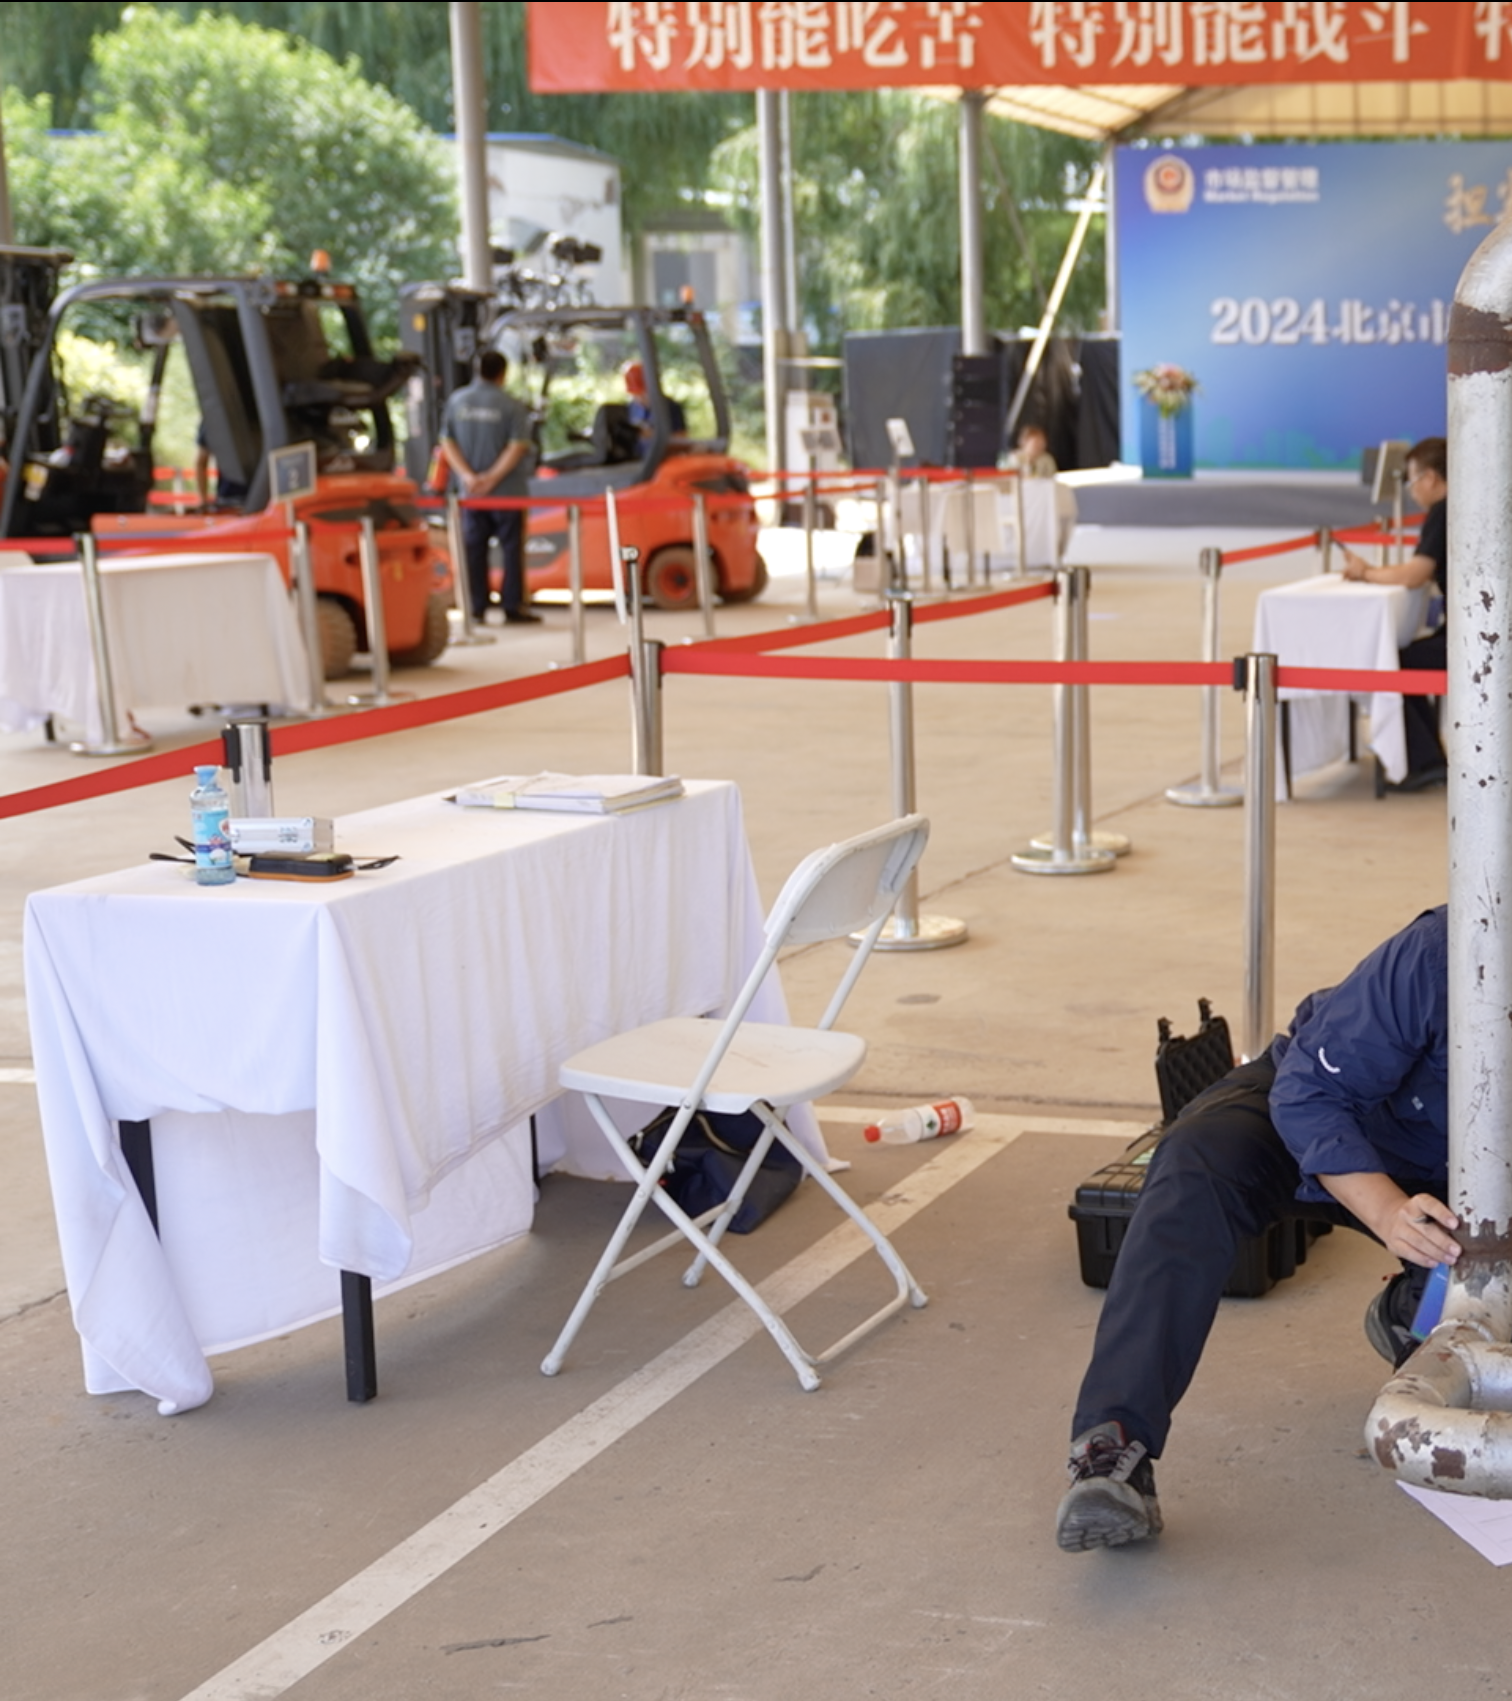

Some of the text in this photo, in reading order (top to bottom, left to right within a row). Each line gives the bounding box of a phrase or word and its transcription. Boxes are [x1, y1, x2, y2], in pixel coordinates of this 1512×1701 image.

[607, 2, 983, 71] 特别能吃苦
[1028, 2, 1430, 69] 特别能战斗
